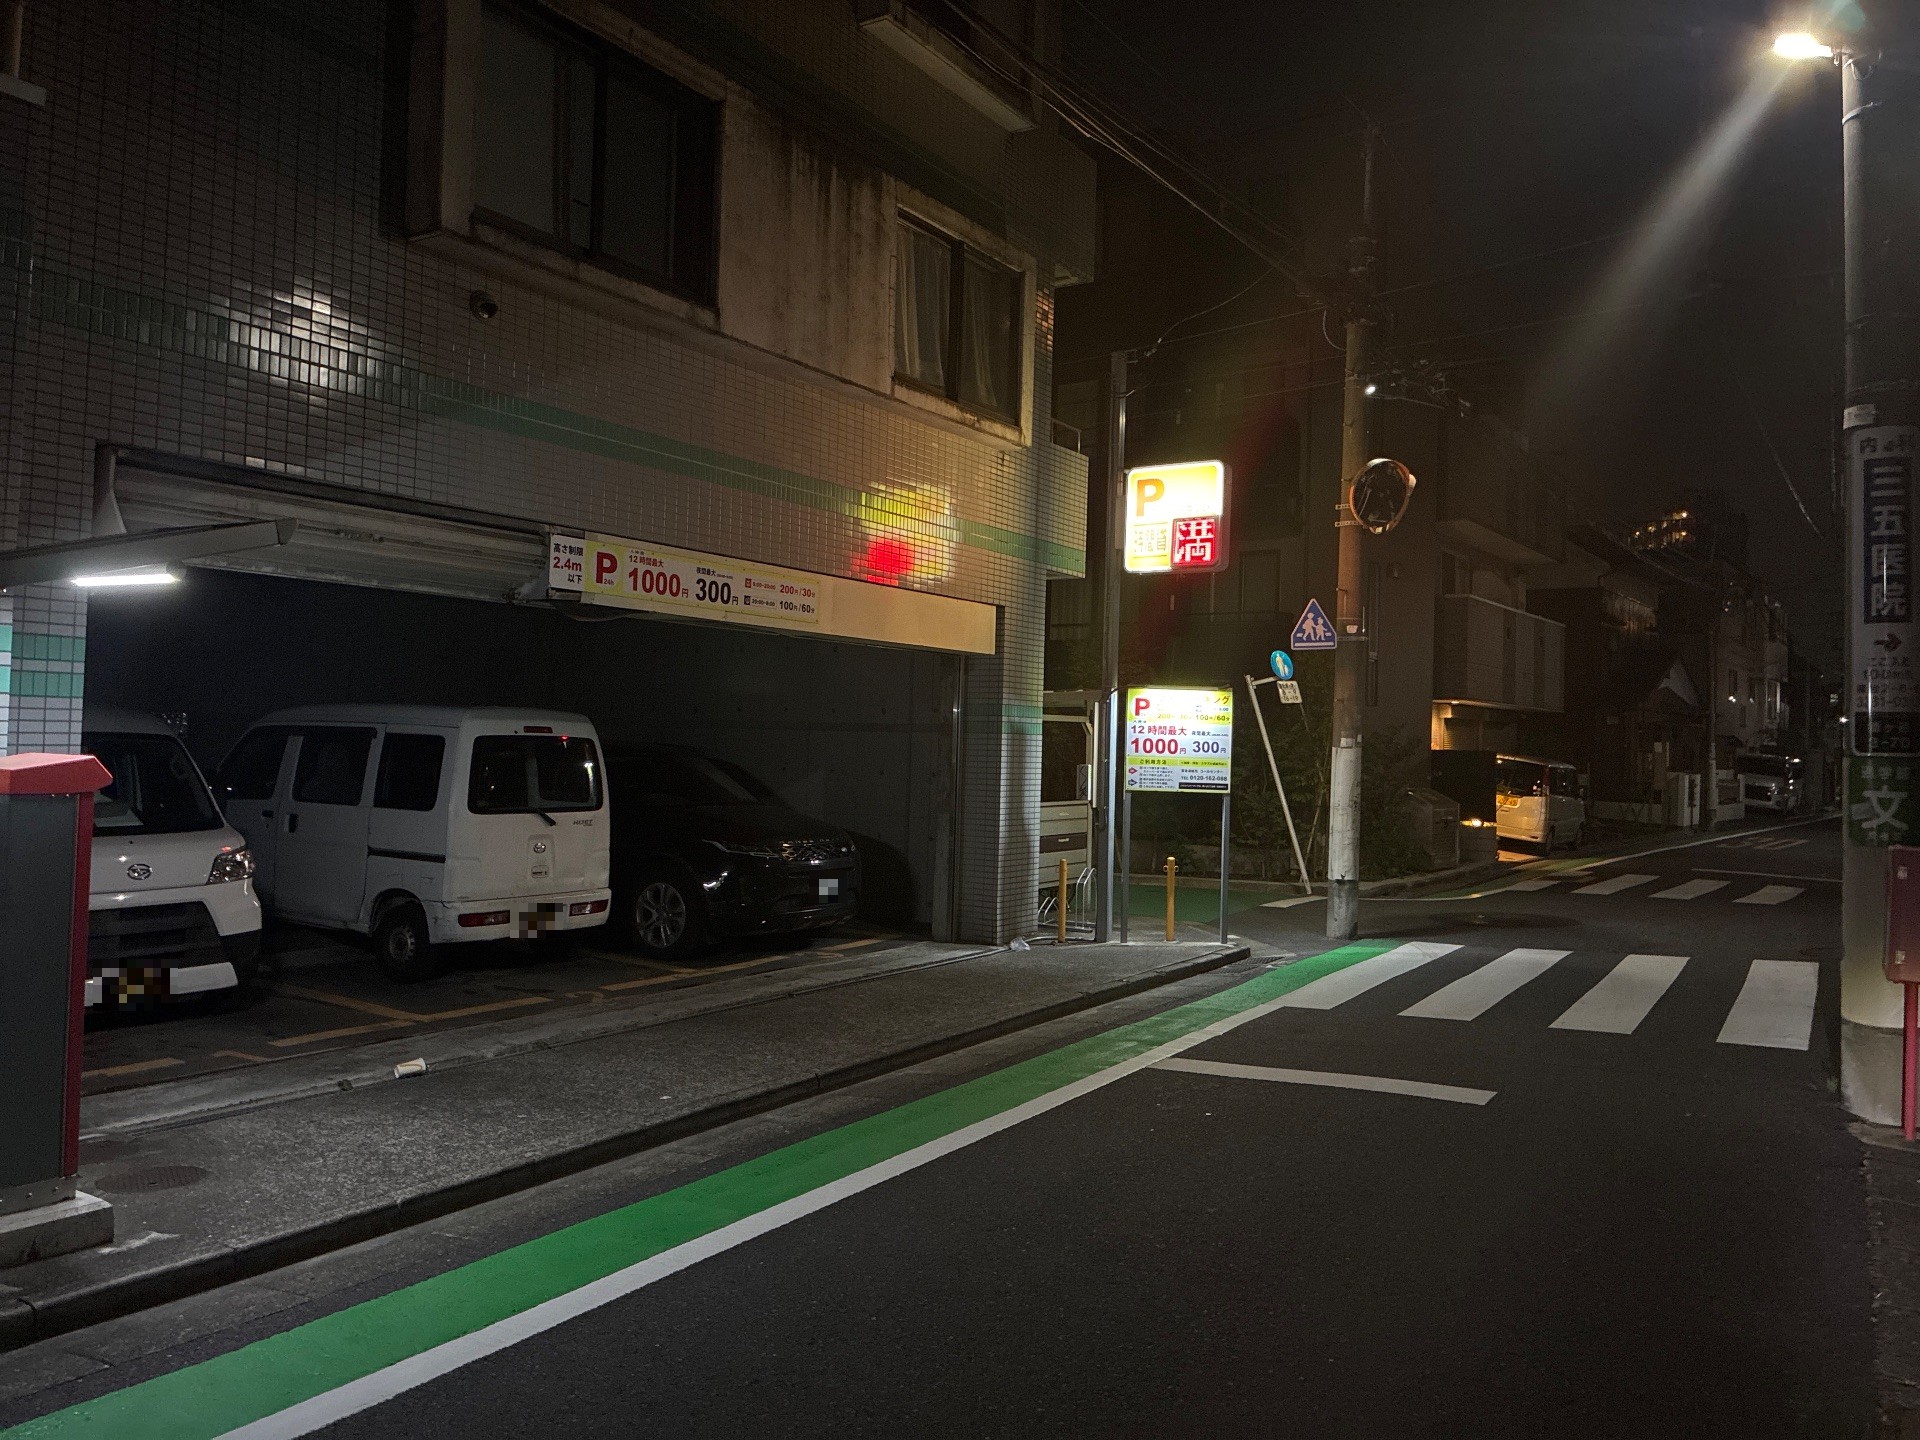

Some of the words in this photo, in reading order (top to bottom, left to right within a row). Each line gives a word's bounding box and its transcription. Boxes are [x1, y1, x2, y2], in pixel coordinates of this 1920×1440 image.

[1136, 478, 1165, 517] P
[553, 542, 584, 557] 高さ制限
[1174, 519, 1215, 563] 満
[552, 556, 582, 572] 2.4m
[595, 551, 618, 584] P
[567, 573, 583, 584] 以下
[1134, 697, 1151, 716] P
[1130, 738, 1187, 755] 1000円
[1192, 741, 1227, 754] 300円
[1861, 784, 1909, 831] 文
